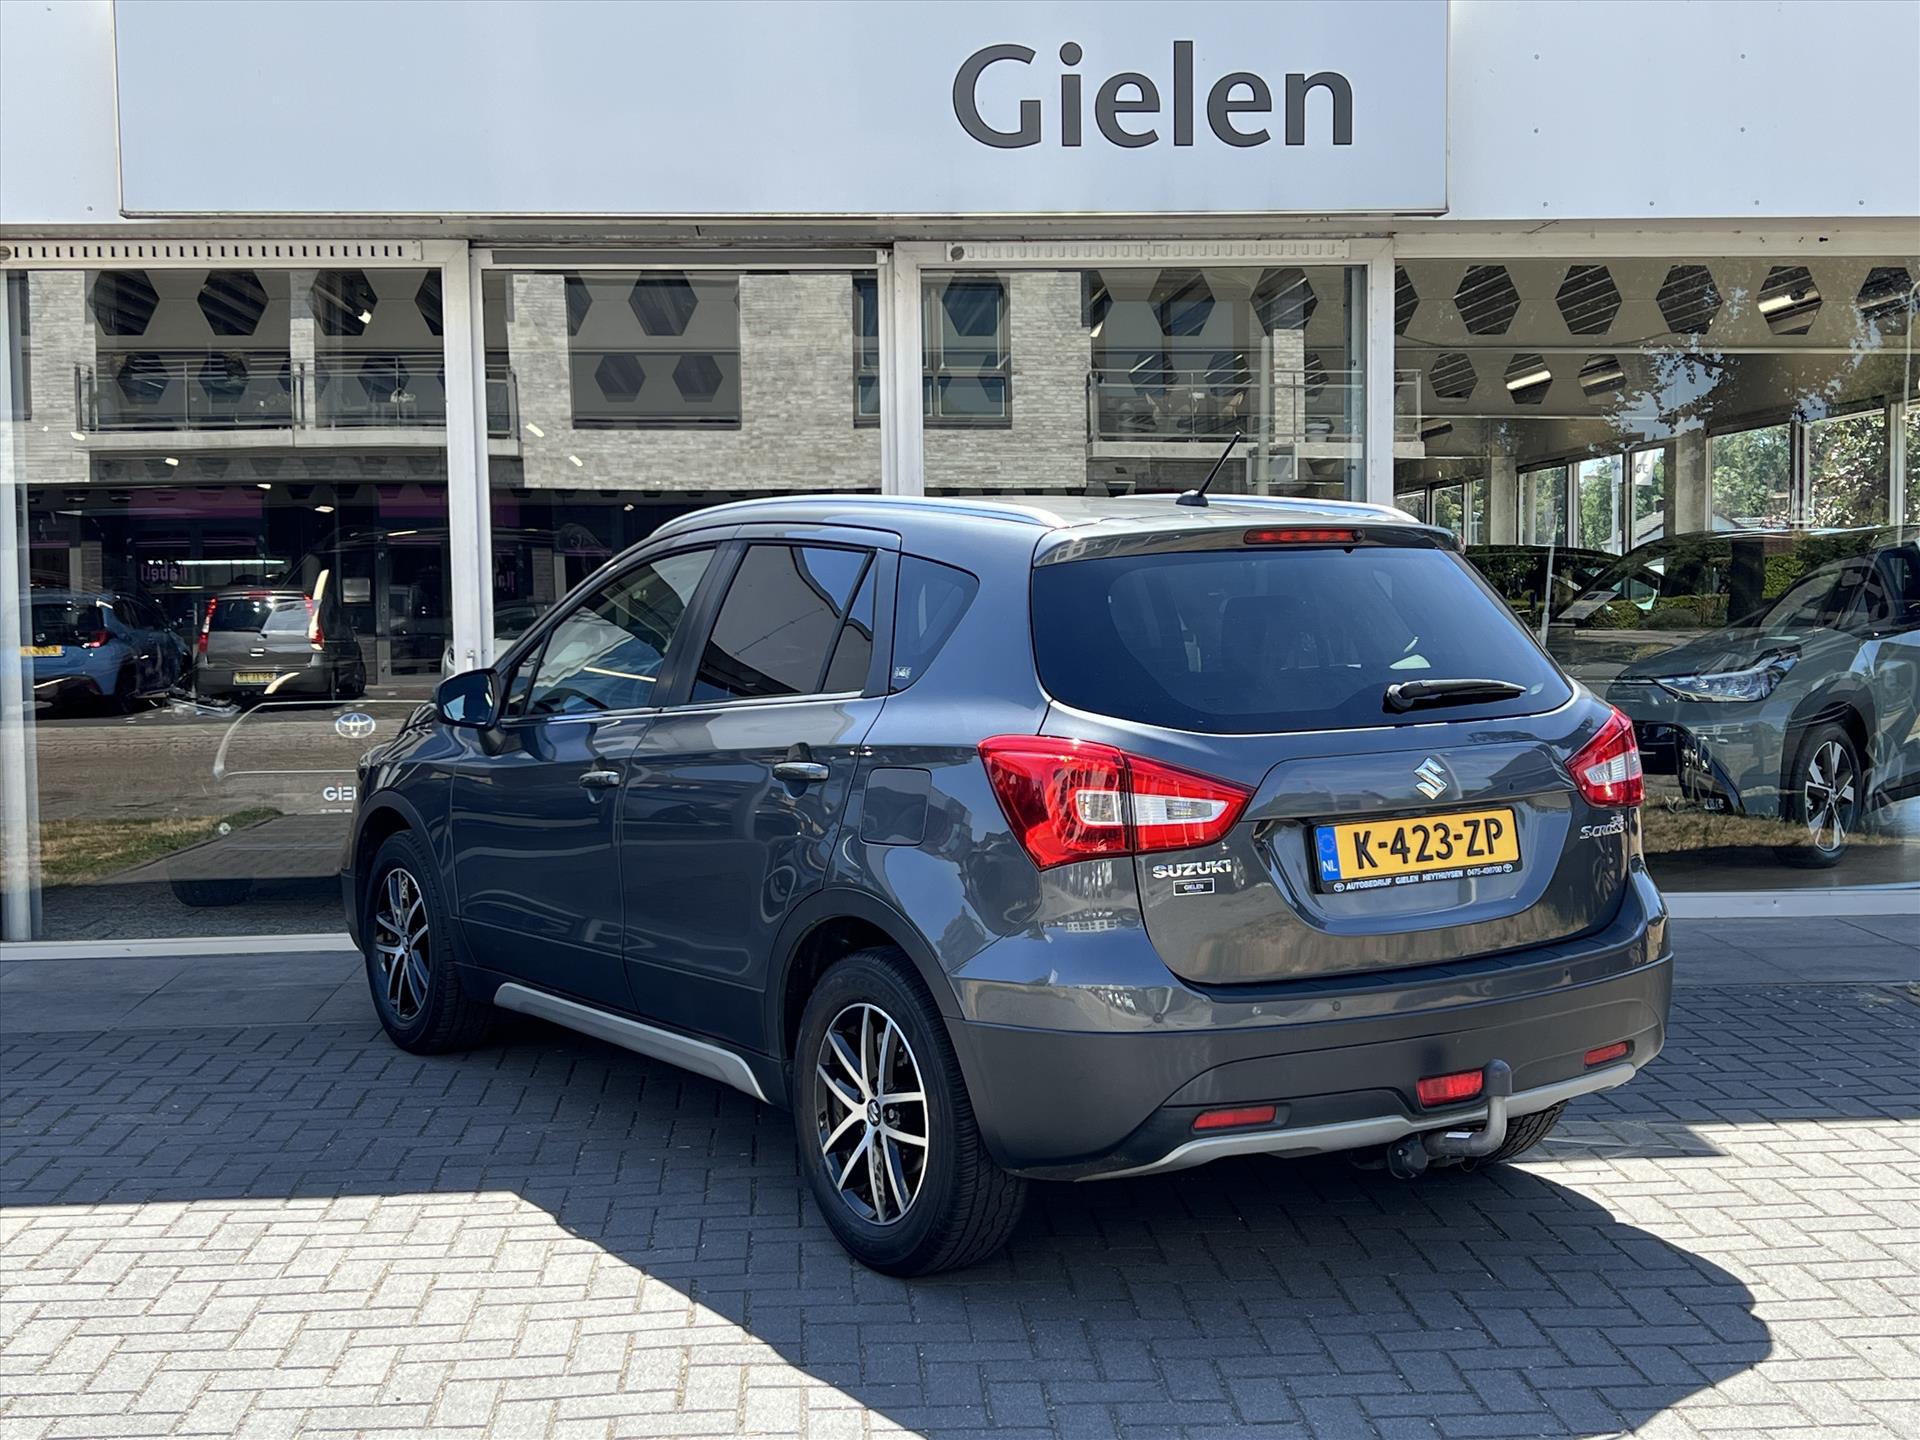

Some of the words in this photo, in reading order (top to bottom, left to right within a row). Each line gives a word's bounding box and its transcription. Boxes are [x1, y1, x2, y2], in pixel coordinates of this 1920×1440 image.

[952, 40, 1353, 149] Gielen
[1353, 817, 1504, 870] K-423-ZP
[1152, 859, 1233, 879] SUZUKI
[1322, 859, 1338, 873] NL
[1395, 875, 1419, 885] GIELEN
